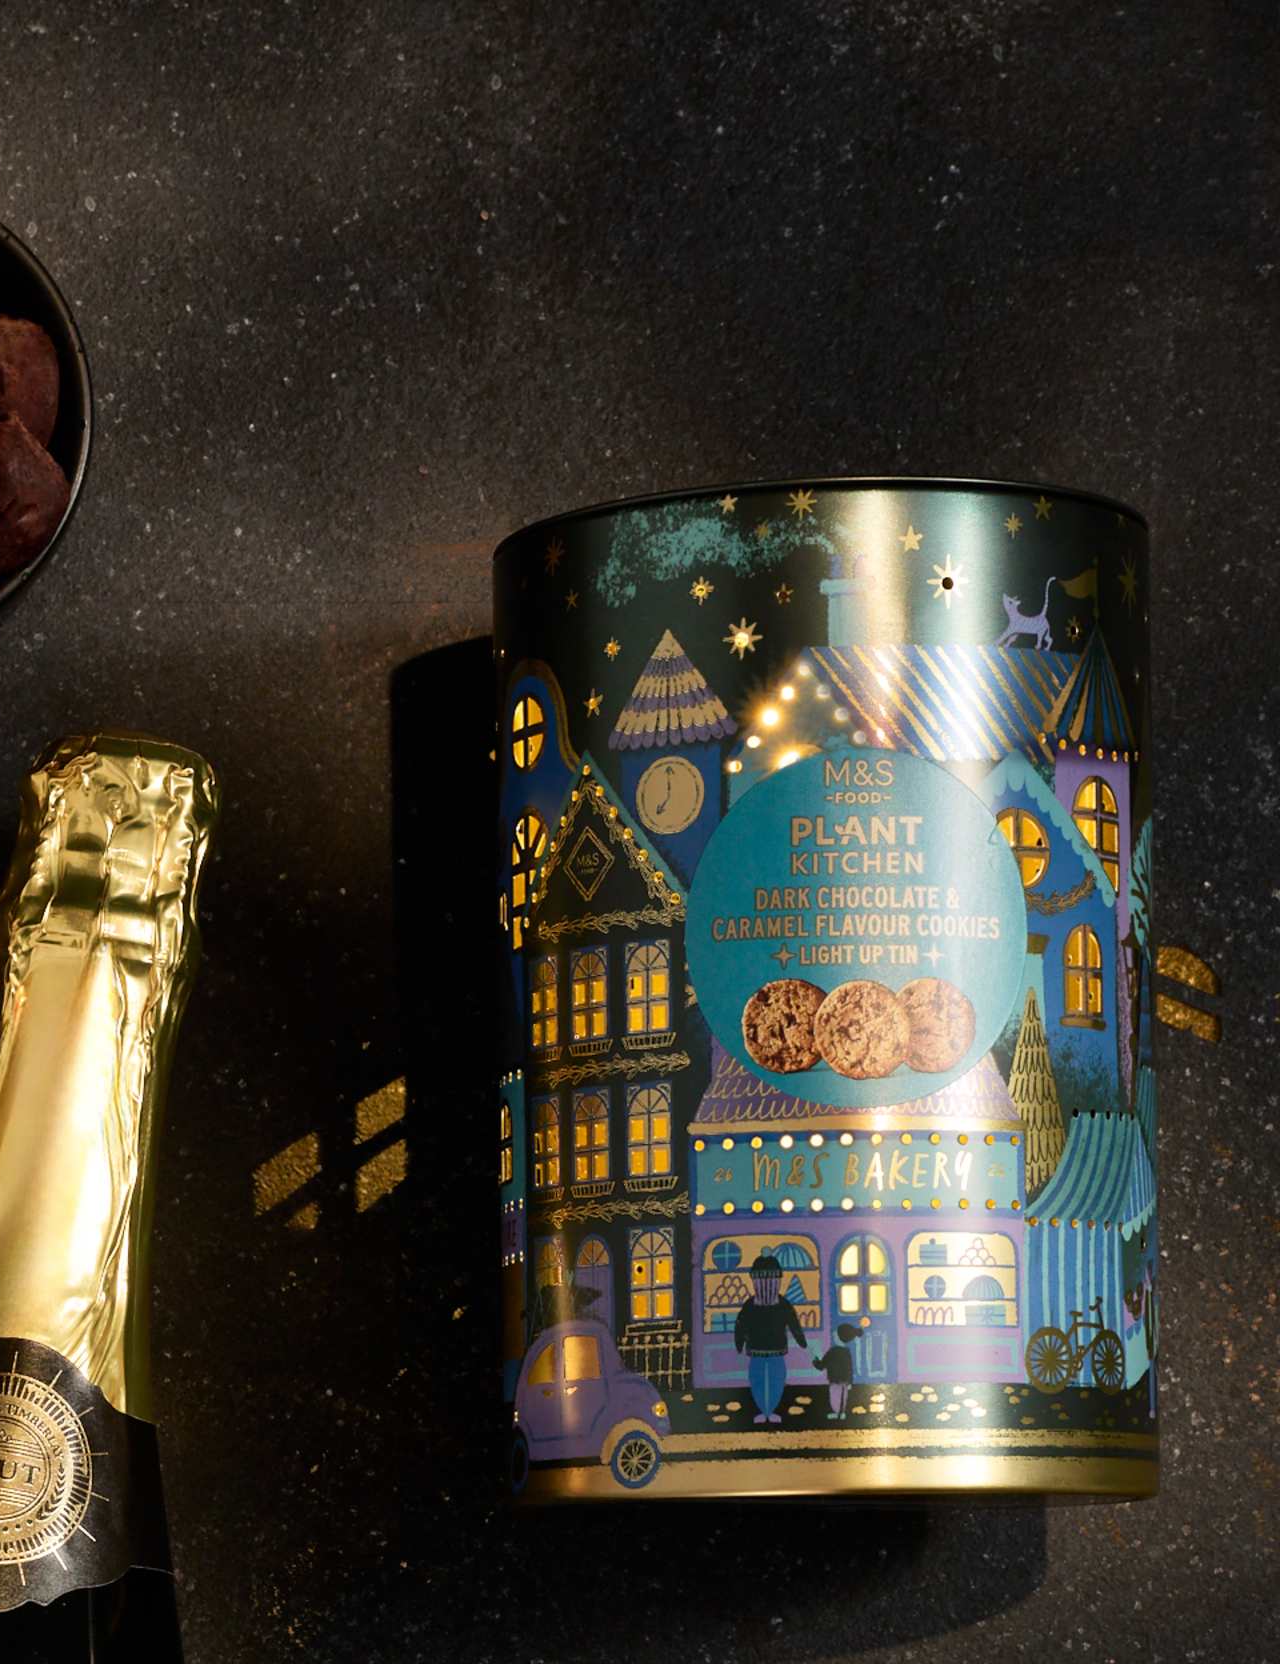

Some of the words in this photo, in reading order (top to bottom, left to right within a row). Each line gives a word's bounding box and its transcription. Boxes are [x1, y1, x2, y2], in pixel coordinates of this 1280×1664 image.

[823, 758, 896, 788] M&S
[790, 815, 923, 847] PLANT
[790, 851, 925, 876] KITCHEN
[754, 887, 811, 911] DARK
[815, 886, 940, 909] CHOCOLATE
[945, 887, 961, 909] &
[711, 915, 809, 941] CARAMEL
[815, 913, 911, 937] FLAVOUR
[915, 915, 1001, 940] COOKIES
[799, 944, 855, 965] LIGHT
[858, 944, 881, 965] UP
[886, 944, 918, 965] TIN
[752, 1151, 830, 1193] M&S
[843, 1149, 975, 1192] BAKERY
[6, 1403, 65, 1459] TIMBERLAY
